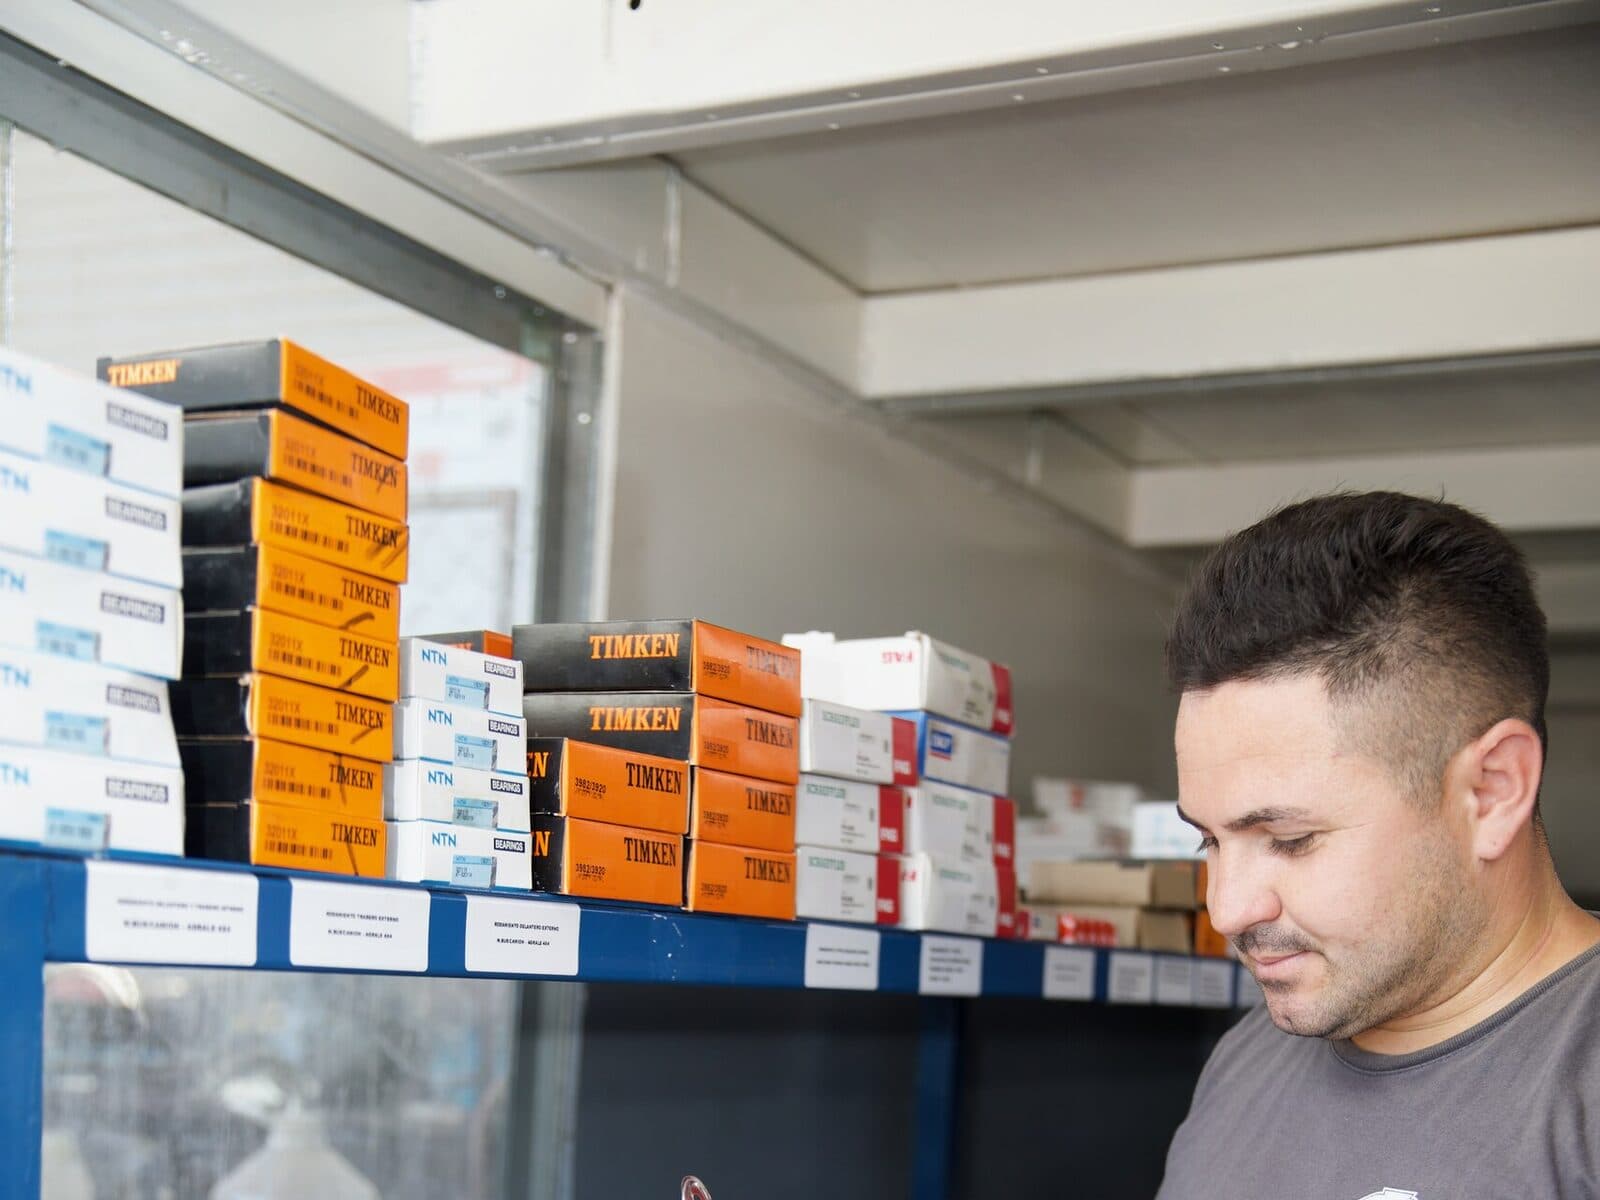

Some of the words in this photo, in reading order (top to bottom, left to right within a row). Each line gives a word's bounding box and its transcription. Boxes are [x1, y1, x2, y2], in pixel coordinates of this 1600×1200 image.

[107, 360, 178, 388] TIMKEN
[356, 385, 400, 425] TIMKEN
[0, 568, 25, 592] TN
[342, 578, 391, 609] TIMKEN
[339, 637, 390, 668] TIMKEN
[421, 648, 447, 667] NTN
[589, 633, 680, 660] TIMKEN
[0, 666, 30, 688] TN
[485, 662, 515, 678] BEARINGS
[335, 701, 384, 730] TIMKEN
[428, 709, 453, 726] NTN
[490, 720, 518, 736] BEARINGS
[589, 706, 682, 731] TIMKEN
[745, 718, 793, 748] TIMKEN
[0, 763, 30, 785] TN
[428, 771, 453, 786] NTN
[625, 762, 683, 795] TIMKEN
[492, 780, 521, 794] BEARINGS
[745, 787, 792, 816] TIMKEN
[331, 823, 378, 848] TIMKEN
[432, 831, 456, 848] NTN
[495, 839, 524, 852] BEARINGS
[624, 837, 676, 867] TIMKEN
[744, 857, 791, 883] TIMKEN
